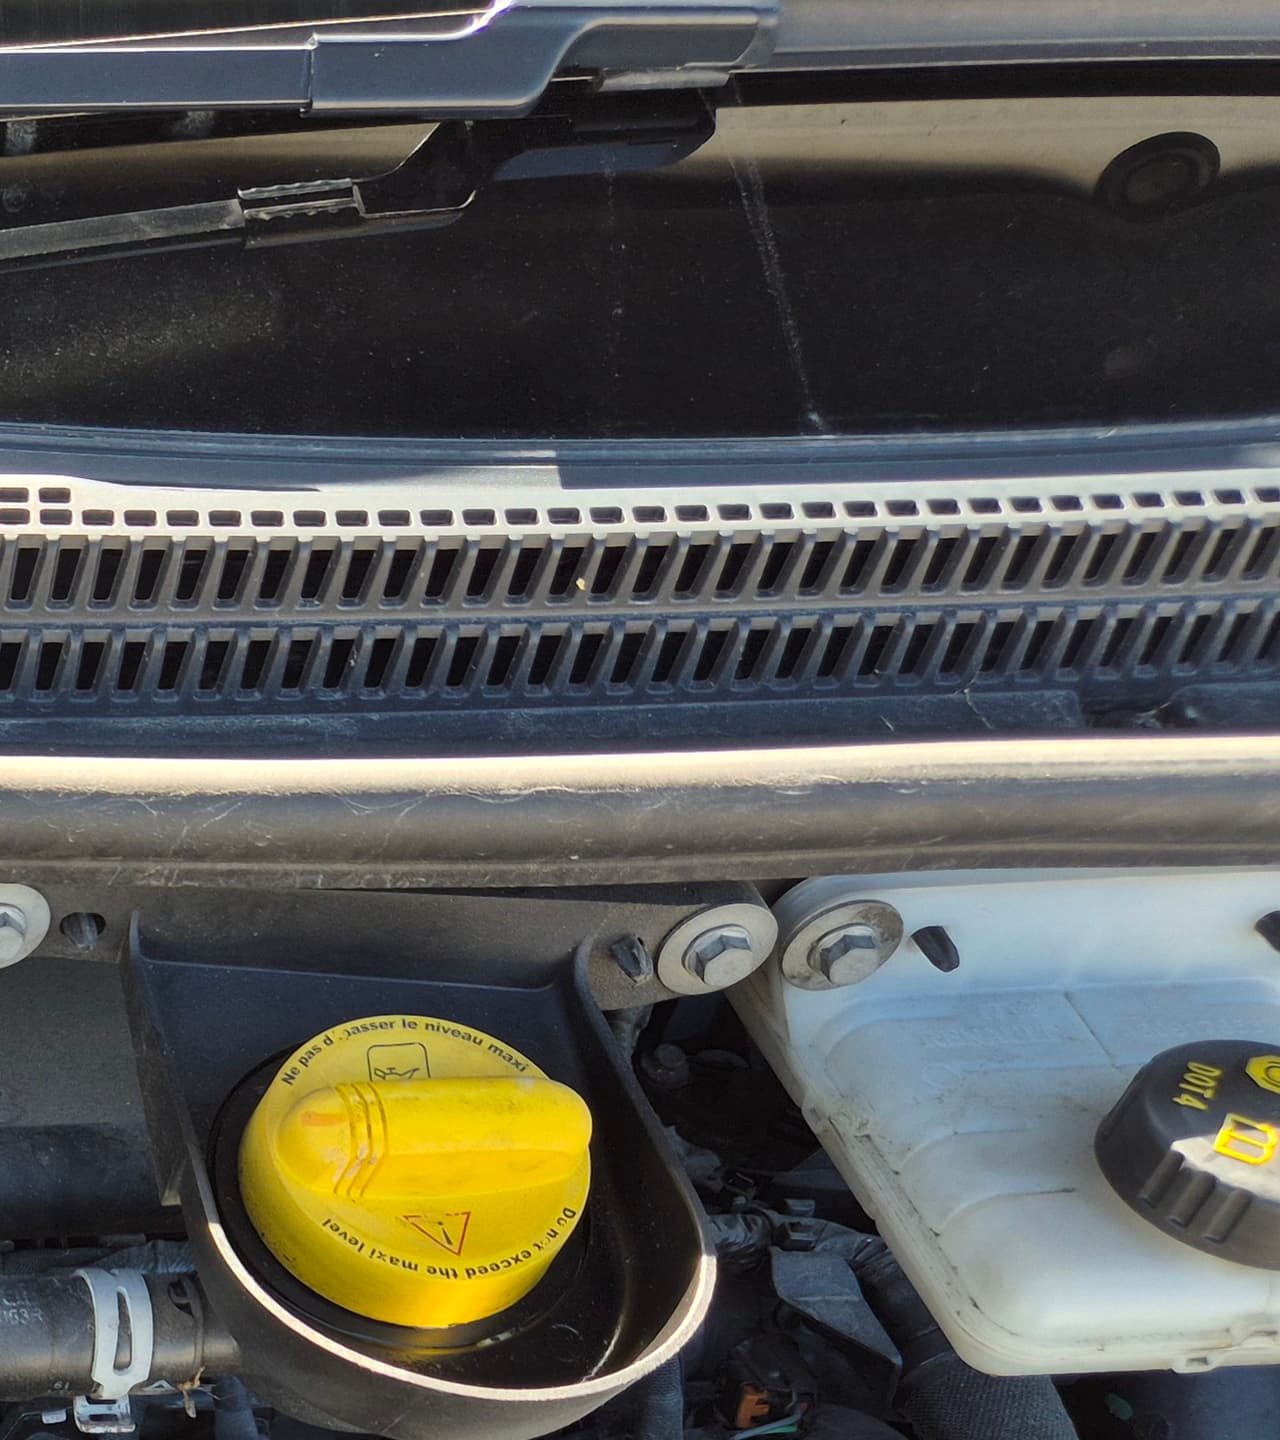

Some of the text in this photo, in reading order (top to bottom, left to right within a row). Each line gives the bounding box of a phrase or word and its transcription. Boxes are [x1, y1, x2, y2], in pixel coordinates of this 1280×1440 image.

[281, 1066, 300, 1086] Ne
[298, 1045, 322, 1068] pas
[402, 1018, 418, 1030] le
[425, 1022, 484, 1046] niveau
[487, 1043, 529, 1073] maxi
[322, 1218, 365, 1253] level
[368, 1247, 419, 1272] maxi
[426, 1265, 458, 1279] the
[465, 1249, 532, 1279] exceed
